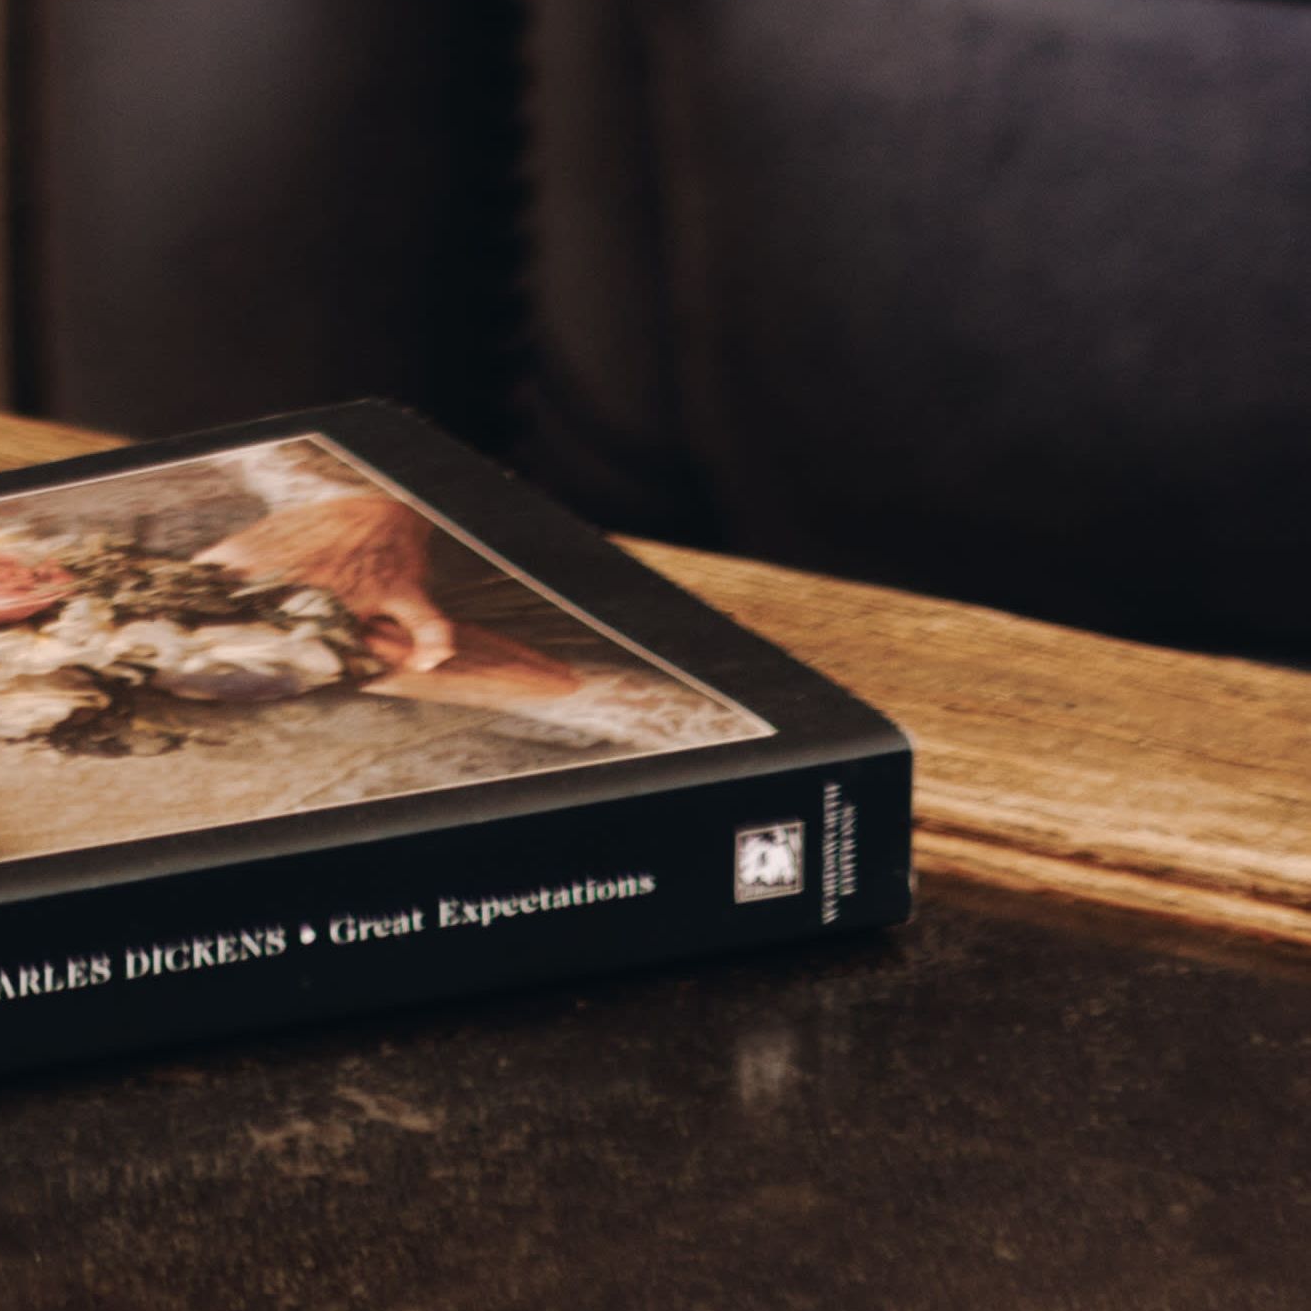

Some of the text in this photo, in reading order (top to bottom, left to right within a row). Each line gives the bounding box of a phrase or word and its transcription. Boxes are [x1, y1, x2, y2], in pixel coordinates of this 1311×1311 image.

[125, 924, 288, 980] DICKENS
[329, 908, 425, 945] Great
[437, 873, 657, 929] Expectations
